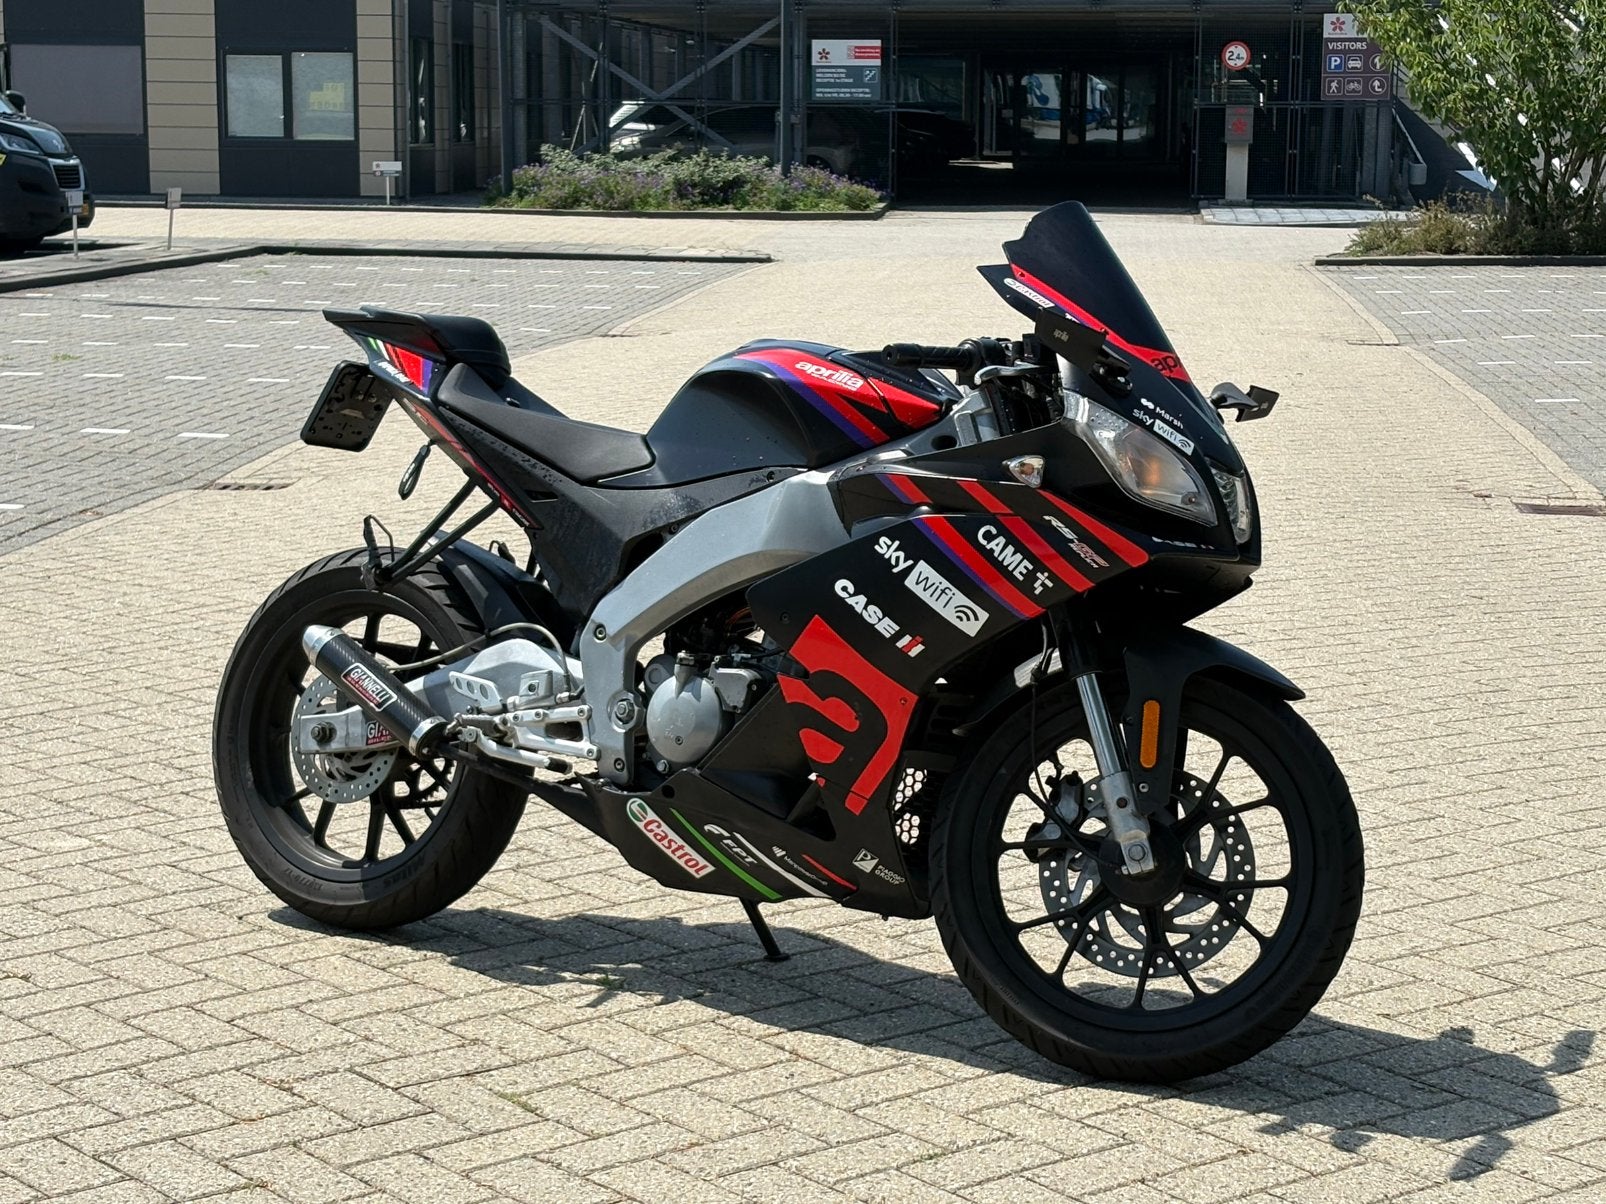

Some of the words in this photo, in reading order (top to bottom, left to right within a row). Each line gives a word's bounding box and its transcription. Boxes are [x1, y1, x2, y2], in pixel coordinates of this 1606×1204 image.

[1327, 41, 1367, 50] VISITORS
[795, 361, 865, 389] aprilia
[1132, 408, 1154, 426] sky
[1155, 406, 1184, 430] Marsh
[977, 524, 1034, 582] CAME
[873, 535, 914, 573] sky
[914, 569, 957, 609] wifi
[833, 578, 901, 638] CASE
[350, 668, 390, 703] GIANNELLI
[642, 818, 710, 877] Castrol
[721, 839, 758, 864] FPT
[874, 869, 900, 885] GROUP
[877, 865, 906, 883] PIAGGIO
